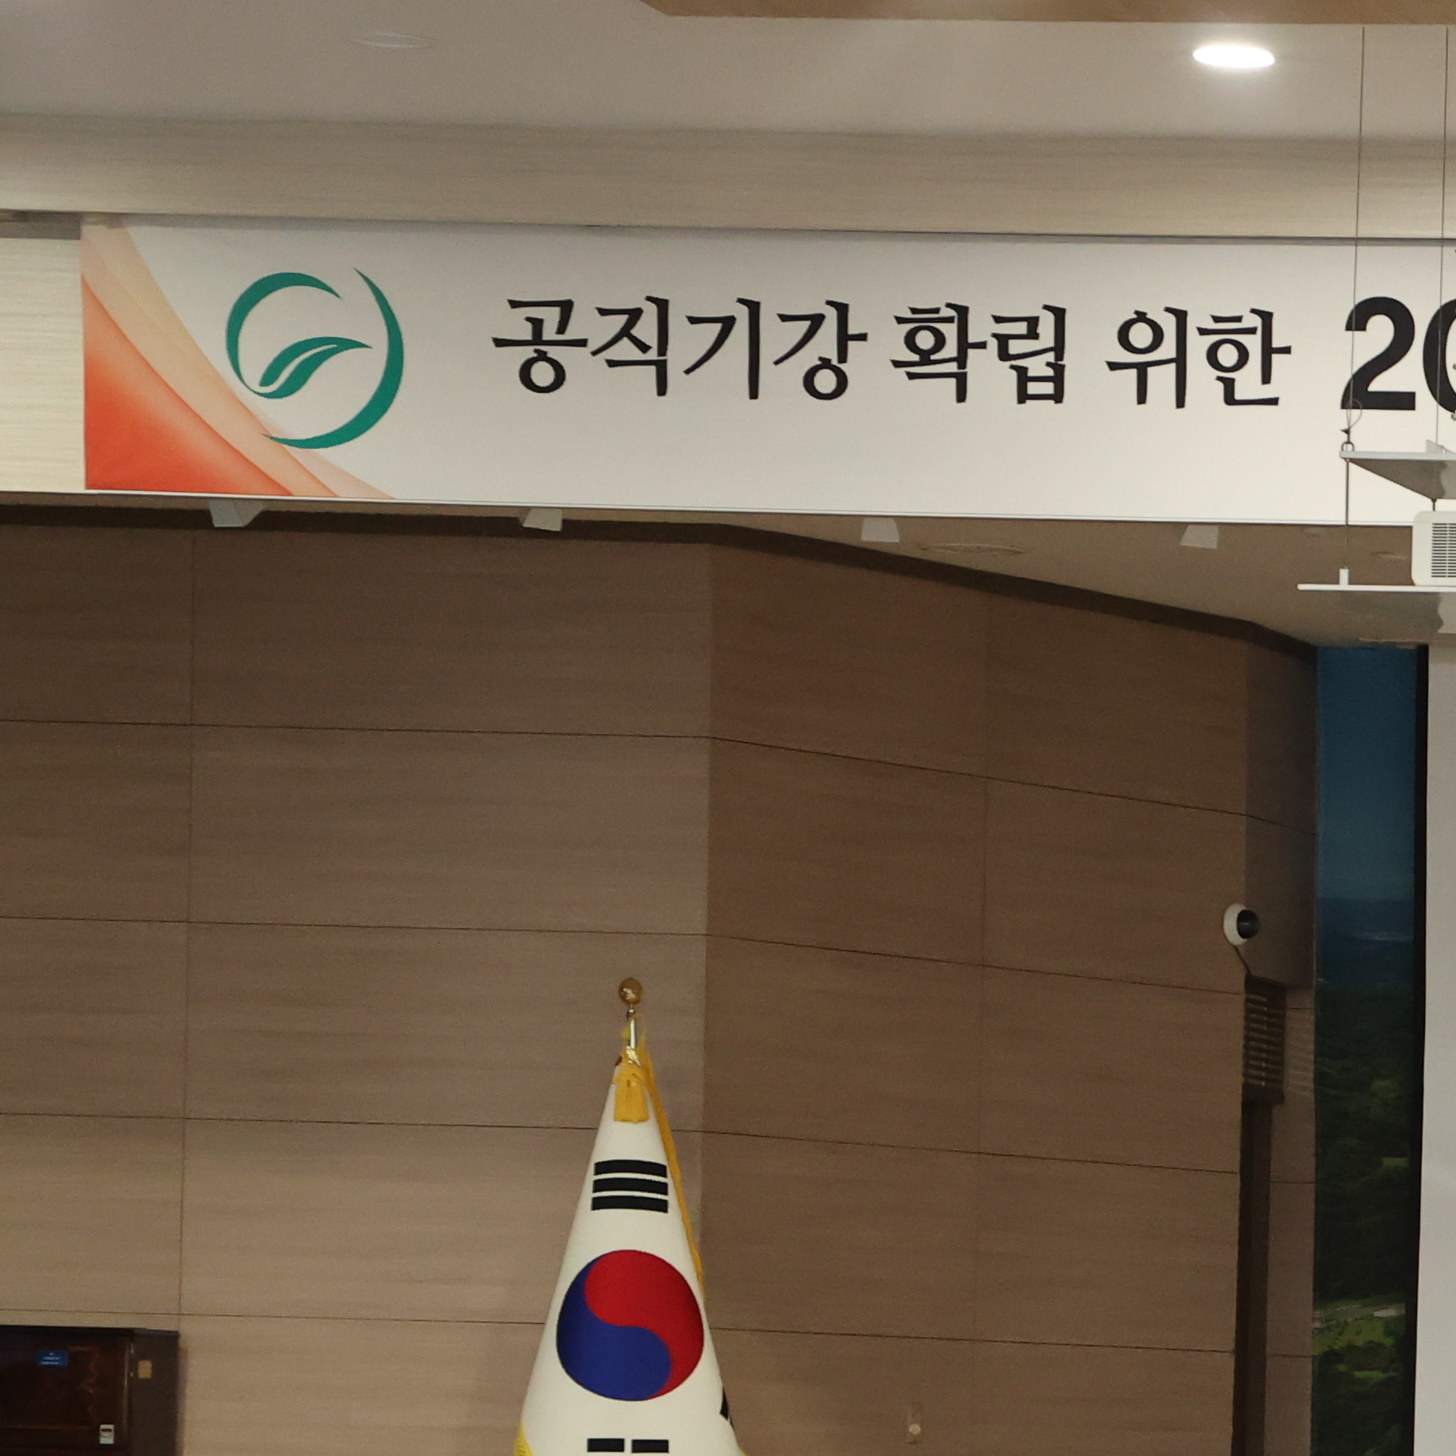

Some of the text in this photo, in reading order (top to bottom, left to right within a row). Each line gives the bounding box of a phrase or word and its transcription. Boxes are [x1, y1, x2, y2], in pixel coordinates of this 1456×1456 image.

[490, 295, 869, 401] 공직기강
[889, 301, 1067, 405] 확립
[1105, 306, 1292, 410] 위한
